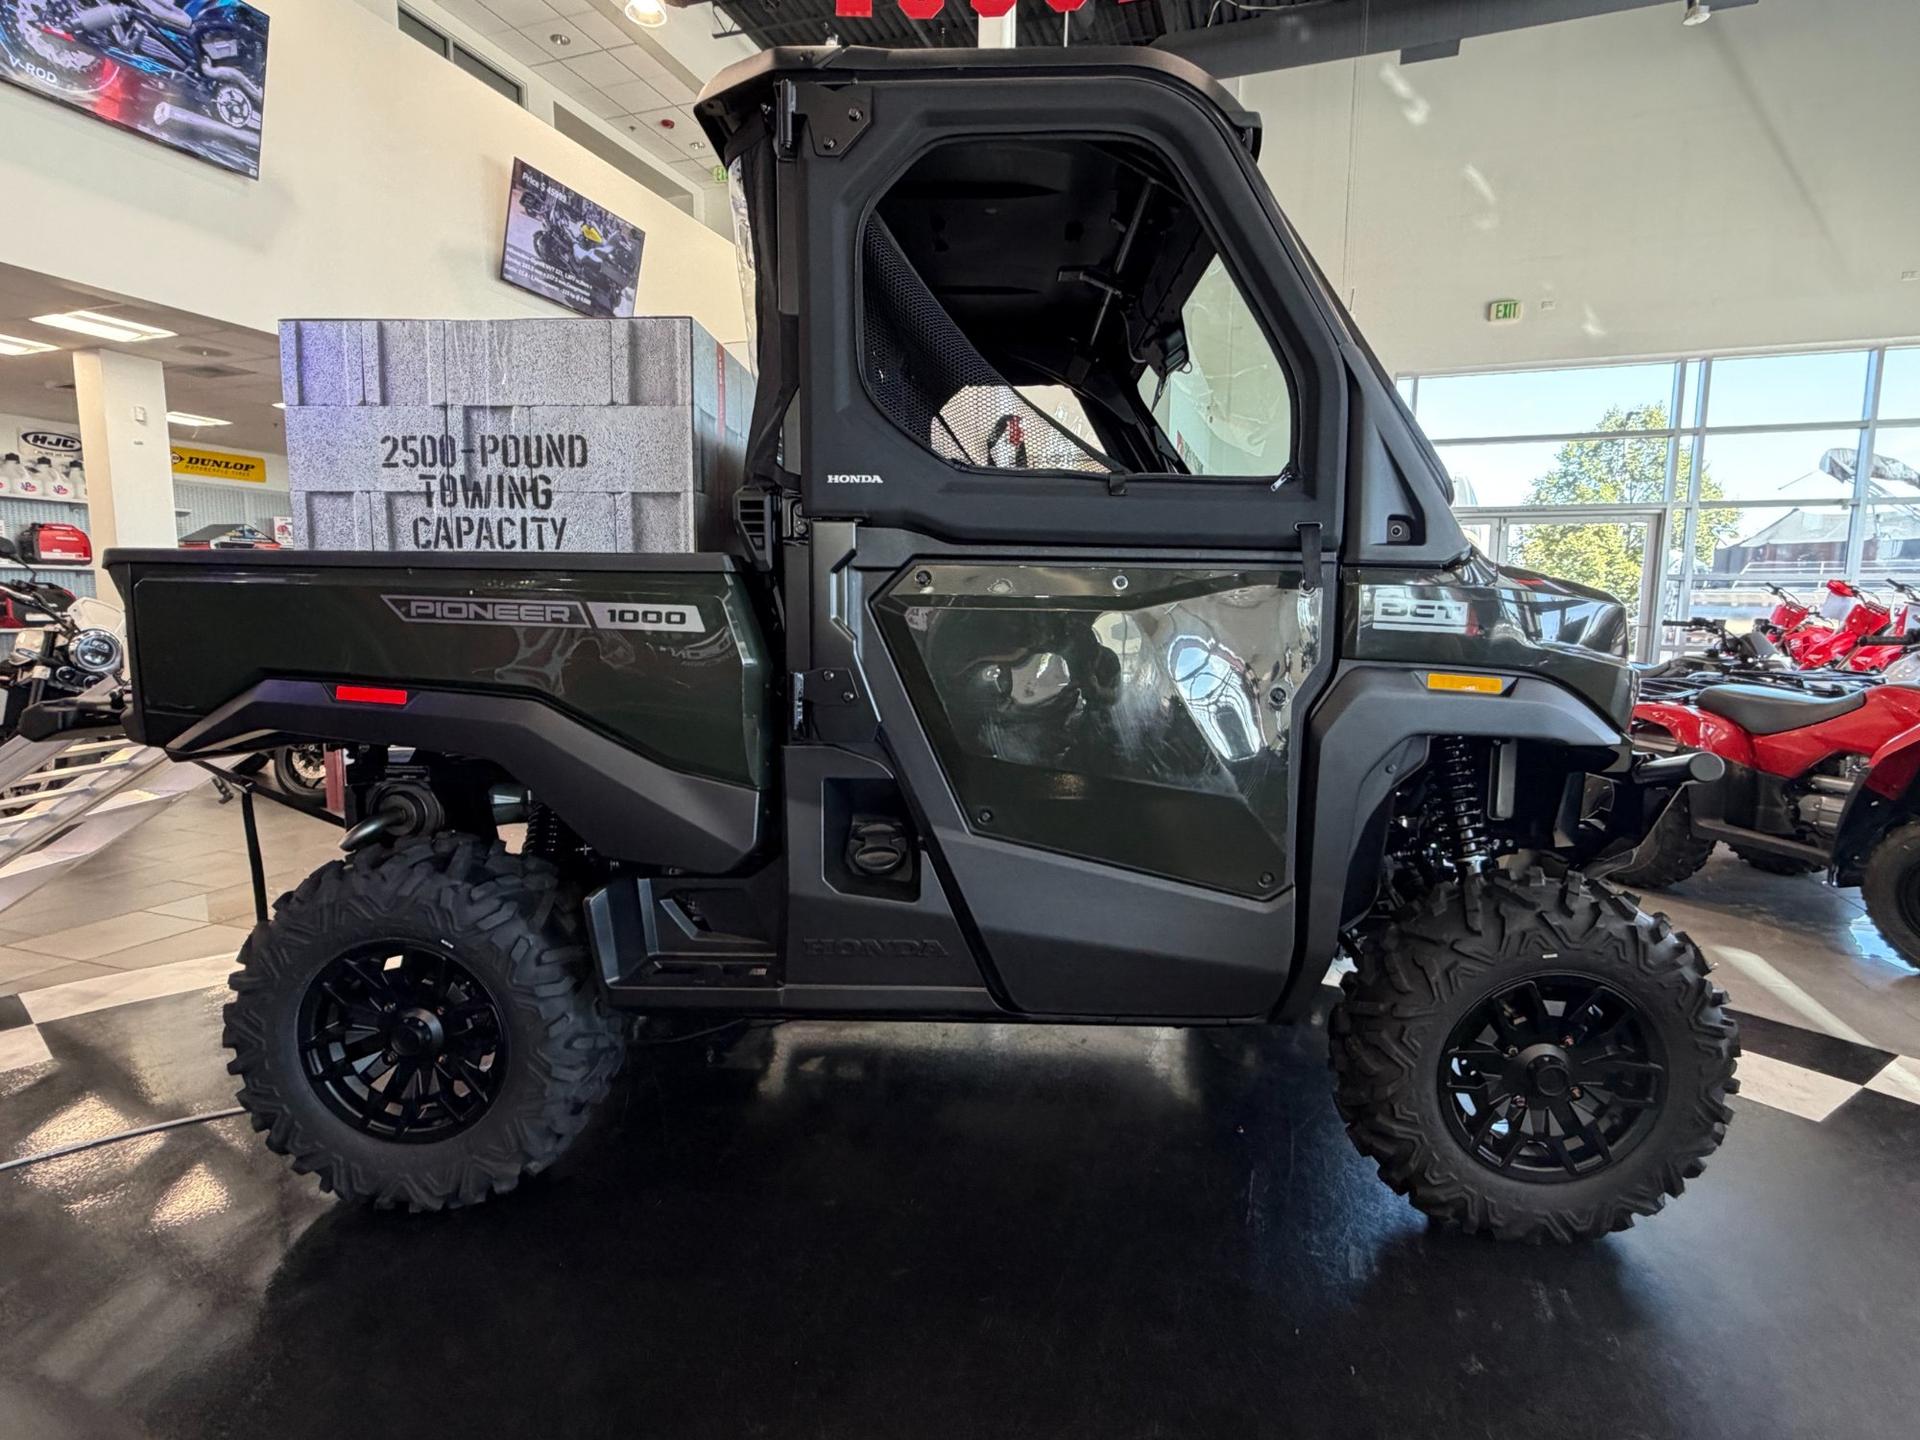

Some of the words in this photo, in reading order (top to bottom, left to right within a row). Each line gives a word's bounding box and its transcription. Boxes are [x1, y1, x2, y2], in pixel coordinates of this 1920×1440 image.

[9, 54, 58, 84] V-ROD
[521, 171, 540, 189] Price
[1495, 303, 1519, 320] EXIT
[31, 434, 77, 449] HJC
[380, 434, 588, 468] 2500-POUND
[187, 456, 256, 472] DUNLOP
[827, 474, 884, 484] HONDA
[418, 474, 553, 510] TOWING
[412, 517, 568, 550] CAPACITY
[410, 600, 570, 623] PIONEER
[608, 609, 687, 625] 1000
[803, 938, 949, 957] HONDA
